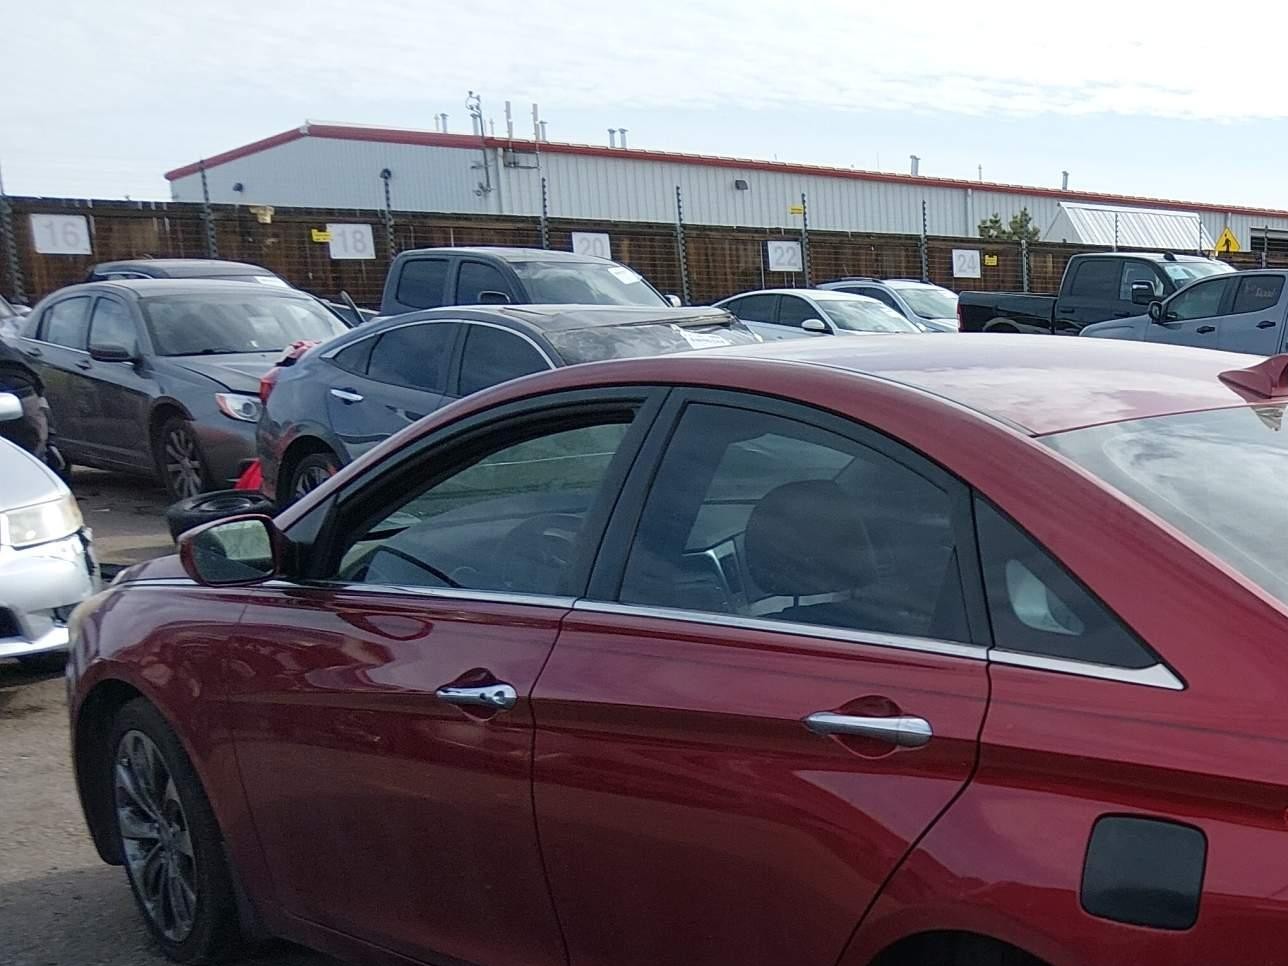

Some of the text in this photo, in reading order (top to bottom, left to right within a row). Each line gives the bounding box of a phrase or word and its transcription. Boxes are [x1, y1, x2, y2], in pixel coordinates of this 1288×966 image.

[43, 219, 82, 248] 16
[337, 228, 369, 254] 18
[579, 237, 606, 258] 20
[774, 245, 798, 267] 22
[957, 253, 977, 273] 24
